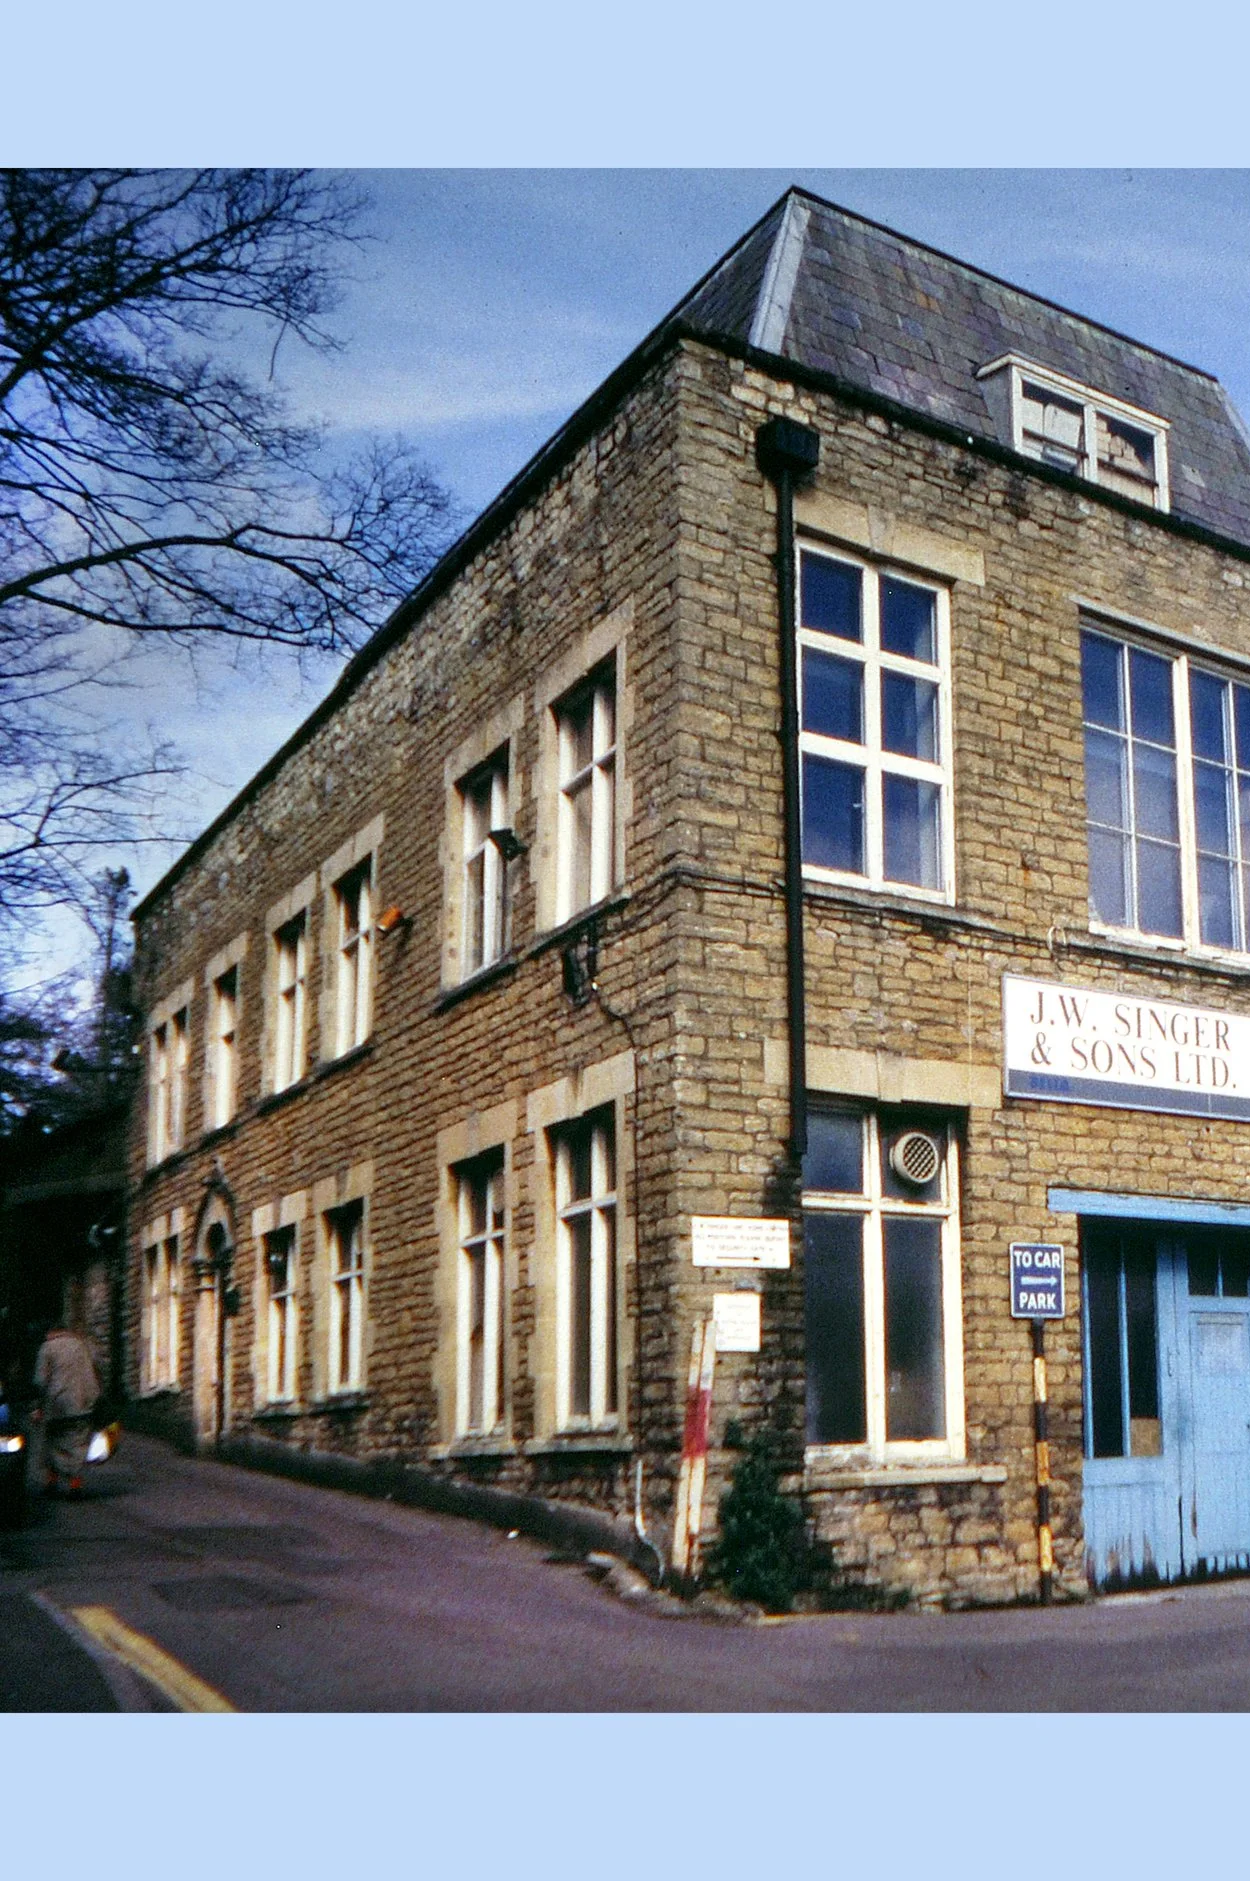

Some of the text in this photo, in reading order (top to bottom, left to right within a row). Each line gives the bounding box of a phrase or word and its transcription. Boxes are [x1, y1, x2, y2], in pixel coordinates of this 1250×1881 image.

[1030, 991, 1231, 1052] J.W. SINGER
[1030, 1032, 1237, 1089] & SONS LTD.
[1013, 1250, 1061, 1268] TO CAR
[1019, 1292, 1056, 1309] PARK
